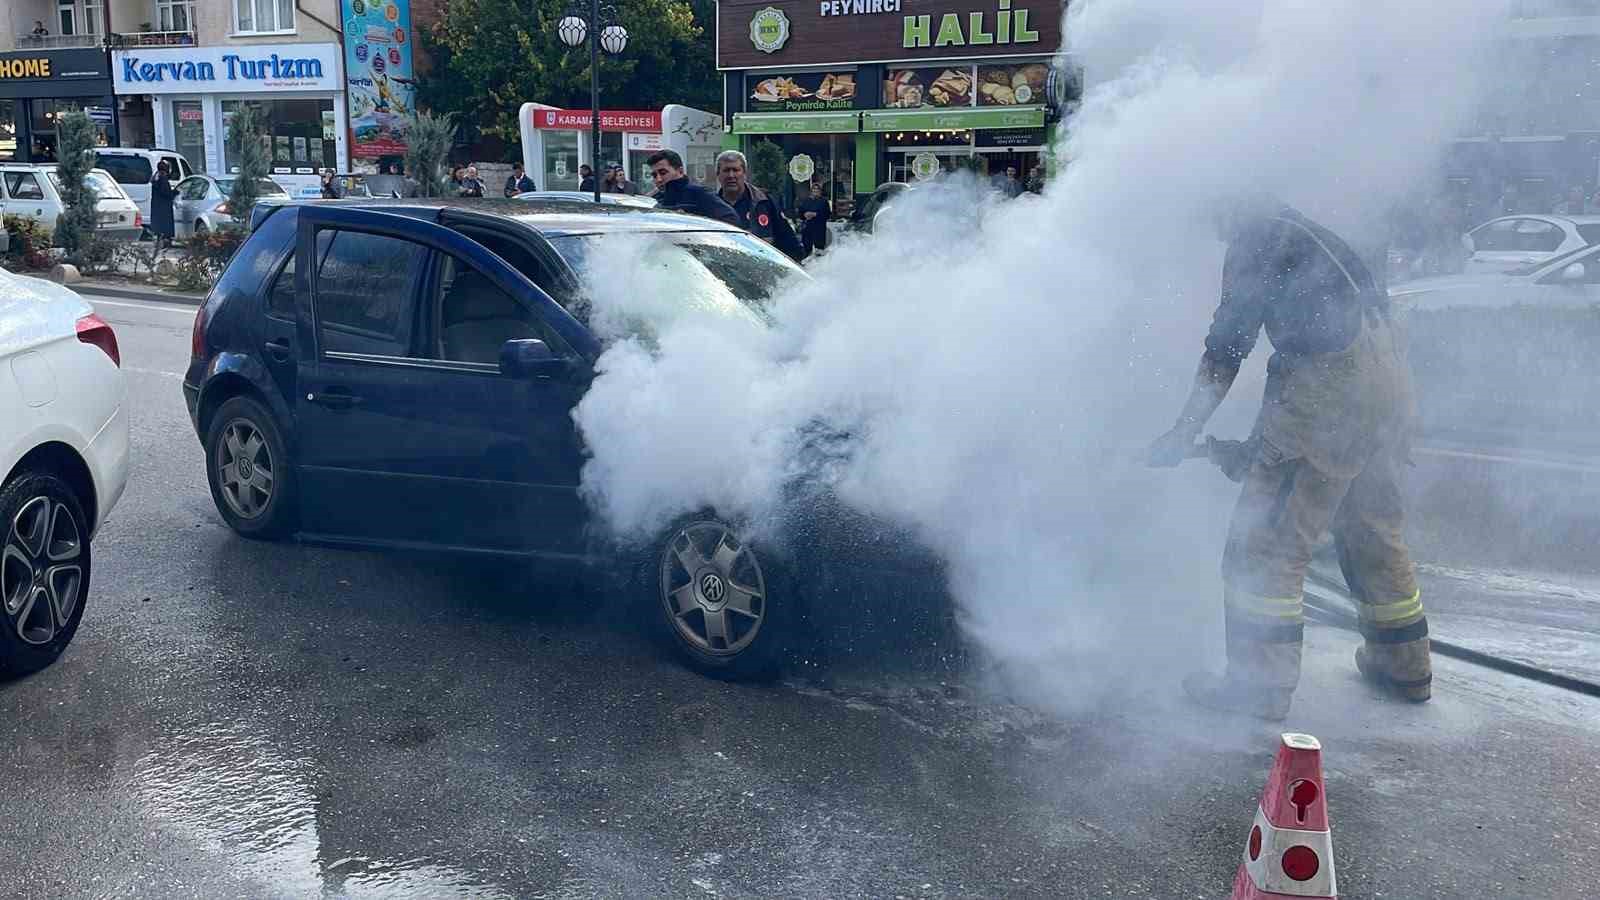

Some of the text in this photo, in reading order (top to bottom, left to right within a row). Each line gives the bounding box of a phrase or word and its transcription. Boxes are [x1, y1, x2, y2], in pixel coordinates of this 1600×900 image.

[902, 0, 1039, 48] HALİL
[0, 59, 50, 77] HOME
[122, 53, 323, 82] Kervan Turizm
[785, 100, 825, 111] Peynirde
[602, 115, 655, 127] BELEDİYESİ
